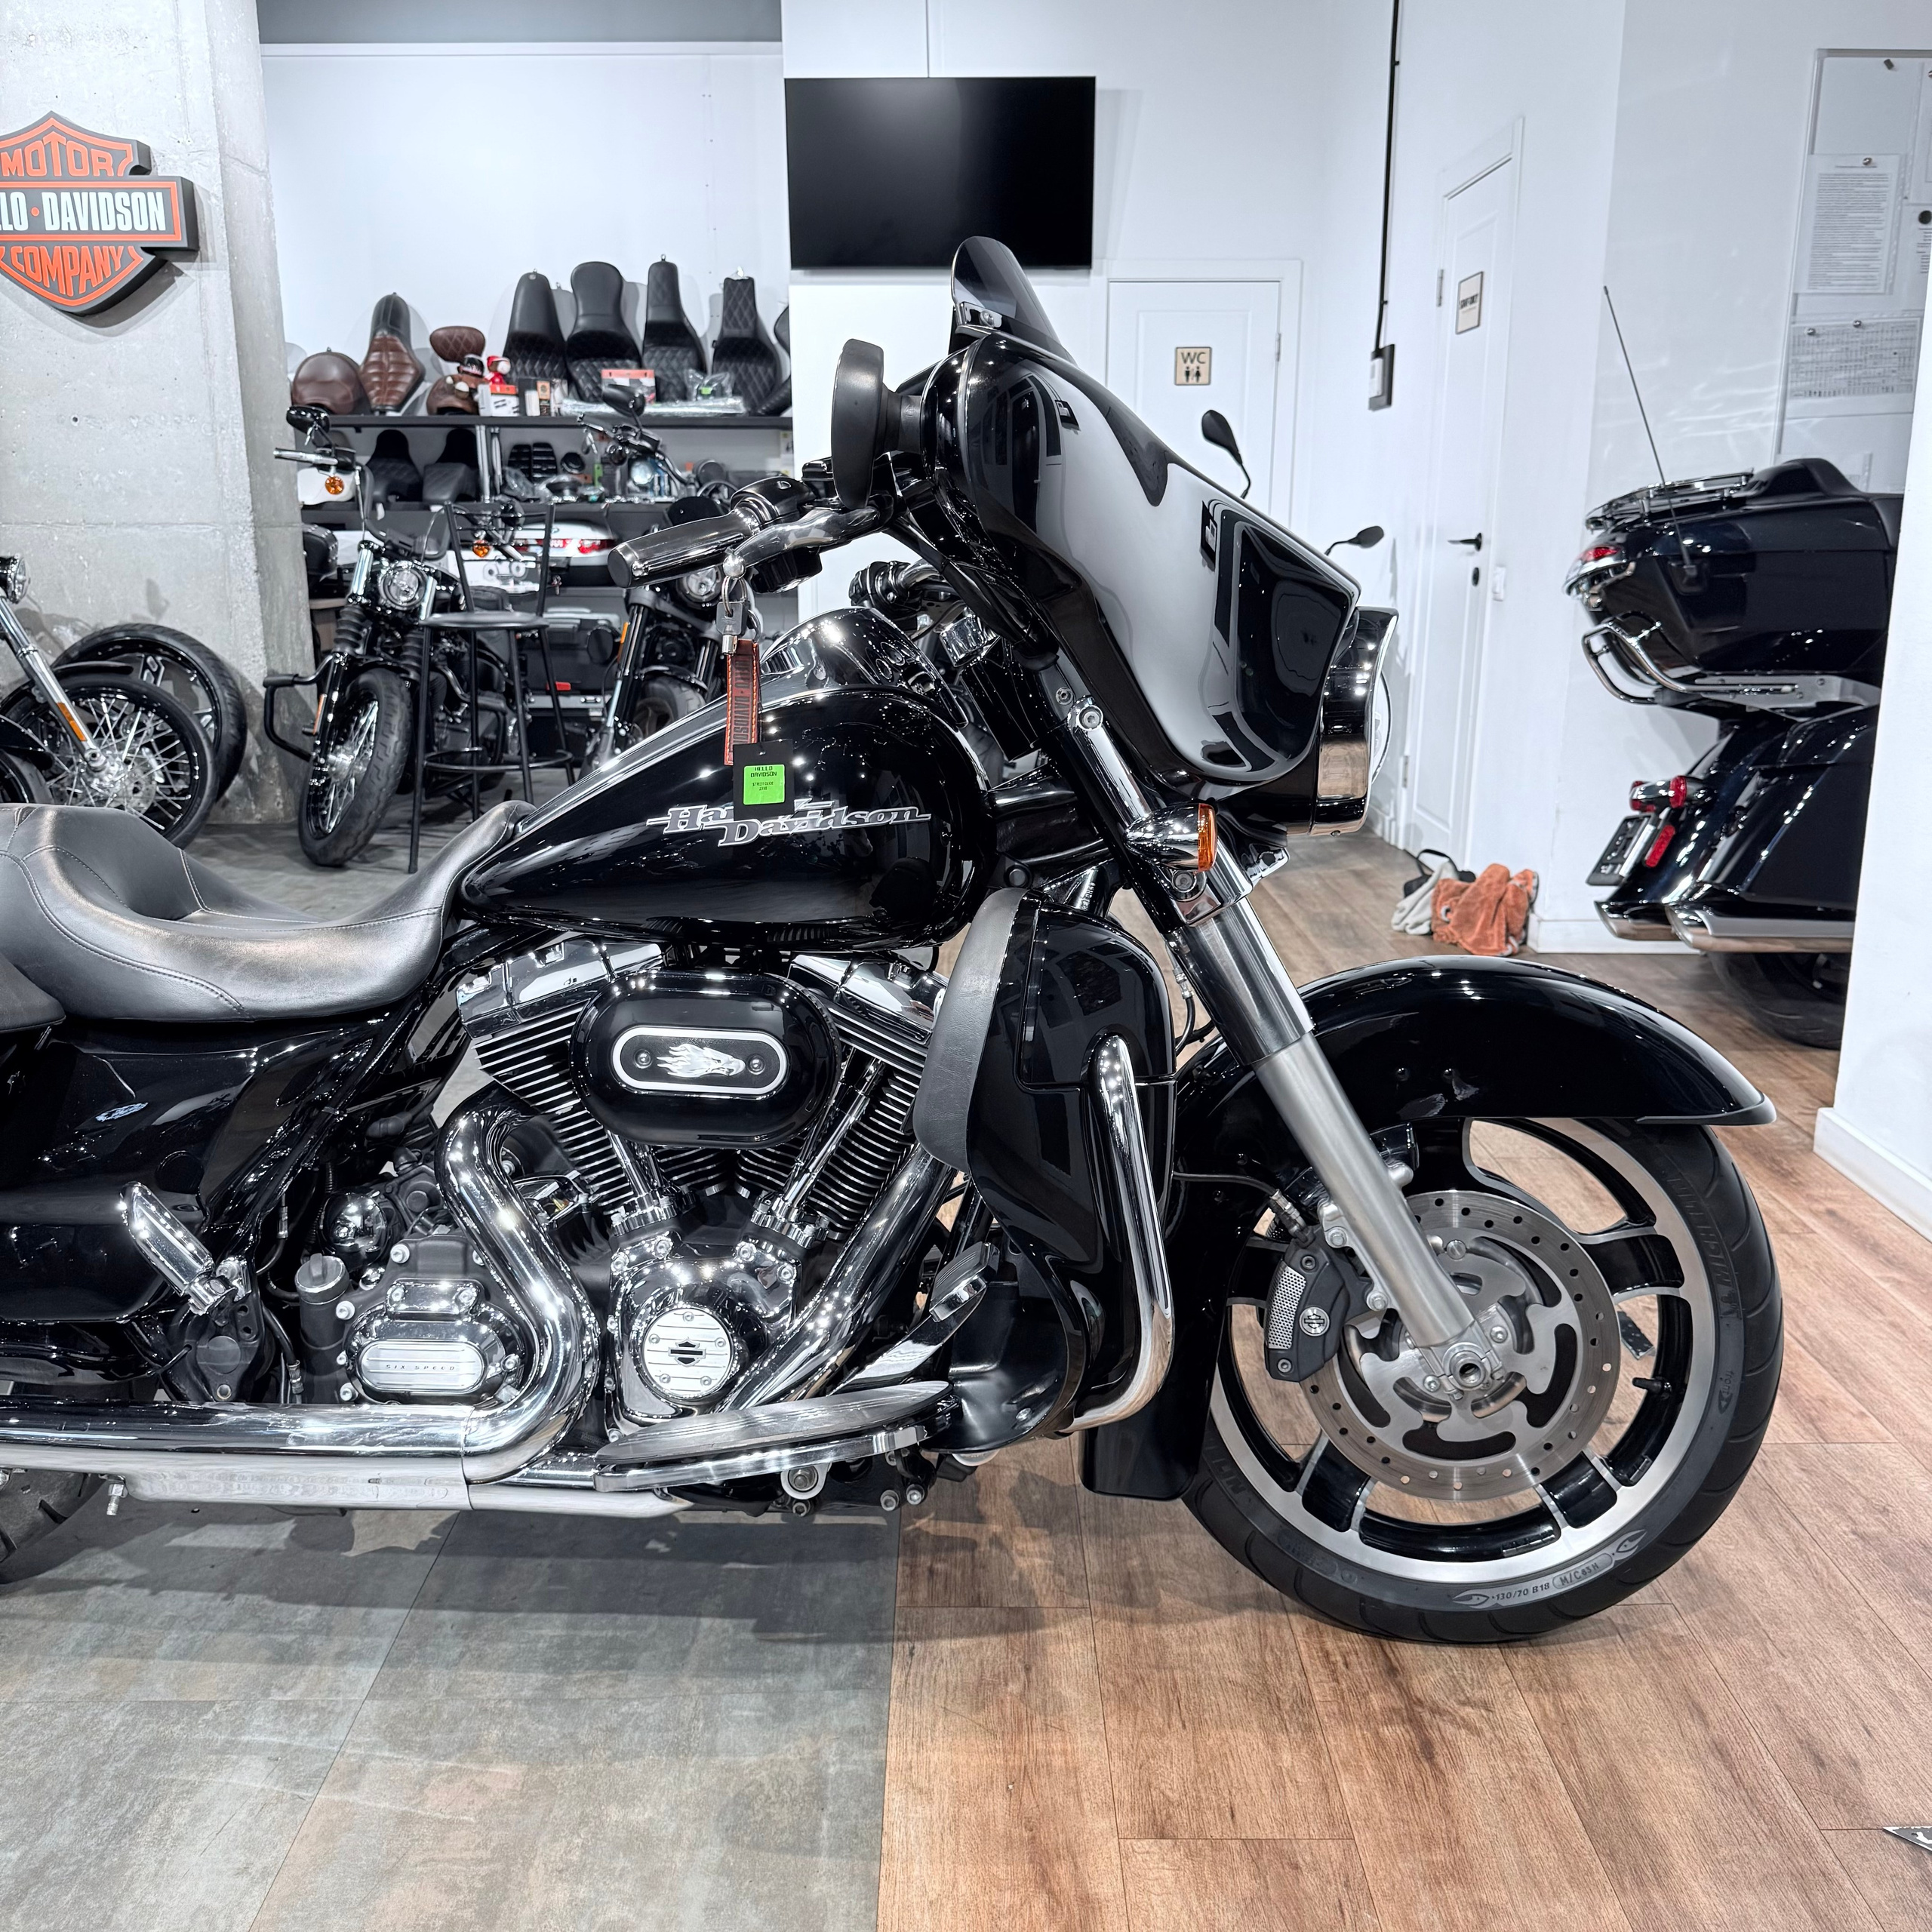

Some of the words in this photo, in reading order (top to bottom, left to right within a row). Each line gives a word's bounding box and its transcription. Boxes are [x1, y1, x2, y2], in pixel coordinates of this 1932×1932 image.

[1, 131, 114, 177] MOTOR
[42, 192, 166, 231] DAVIDSON
[11, 246, 124, 297] COMPANY
[1181, 352, 1206, 364] WC
[701, 805, 931, 847] Davidson
[1497, 1588, 1529, 1600] 130/70
[1559, 1572, 1582, 1586] M/C
